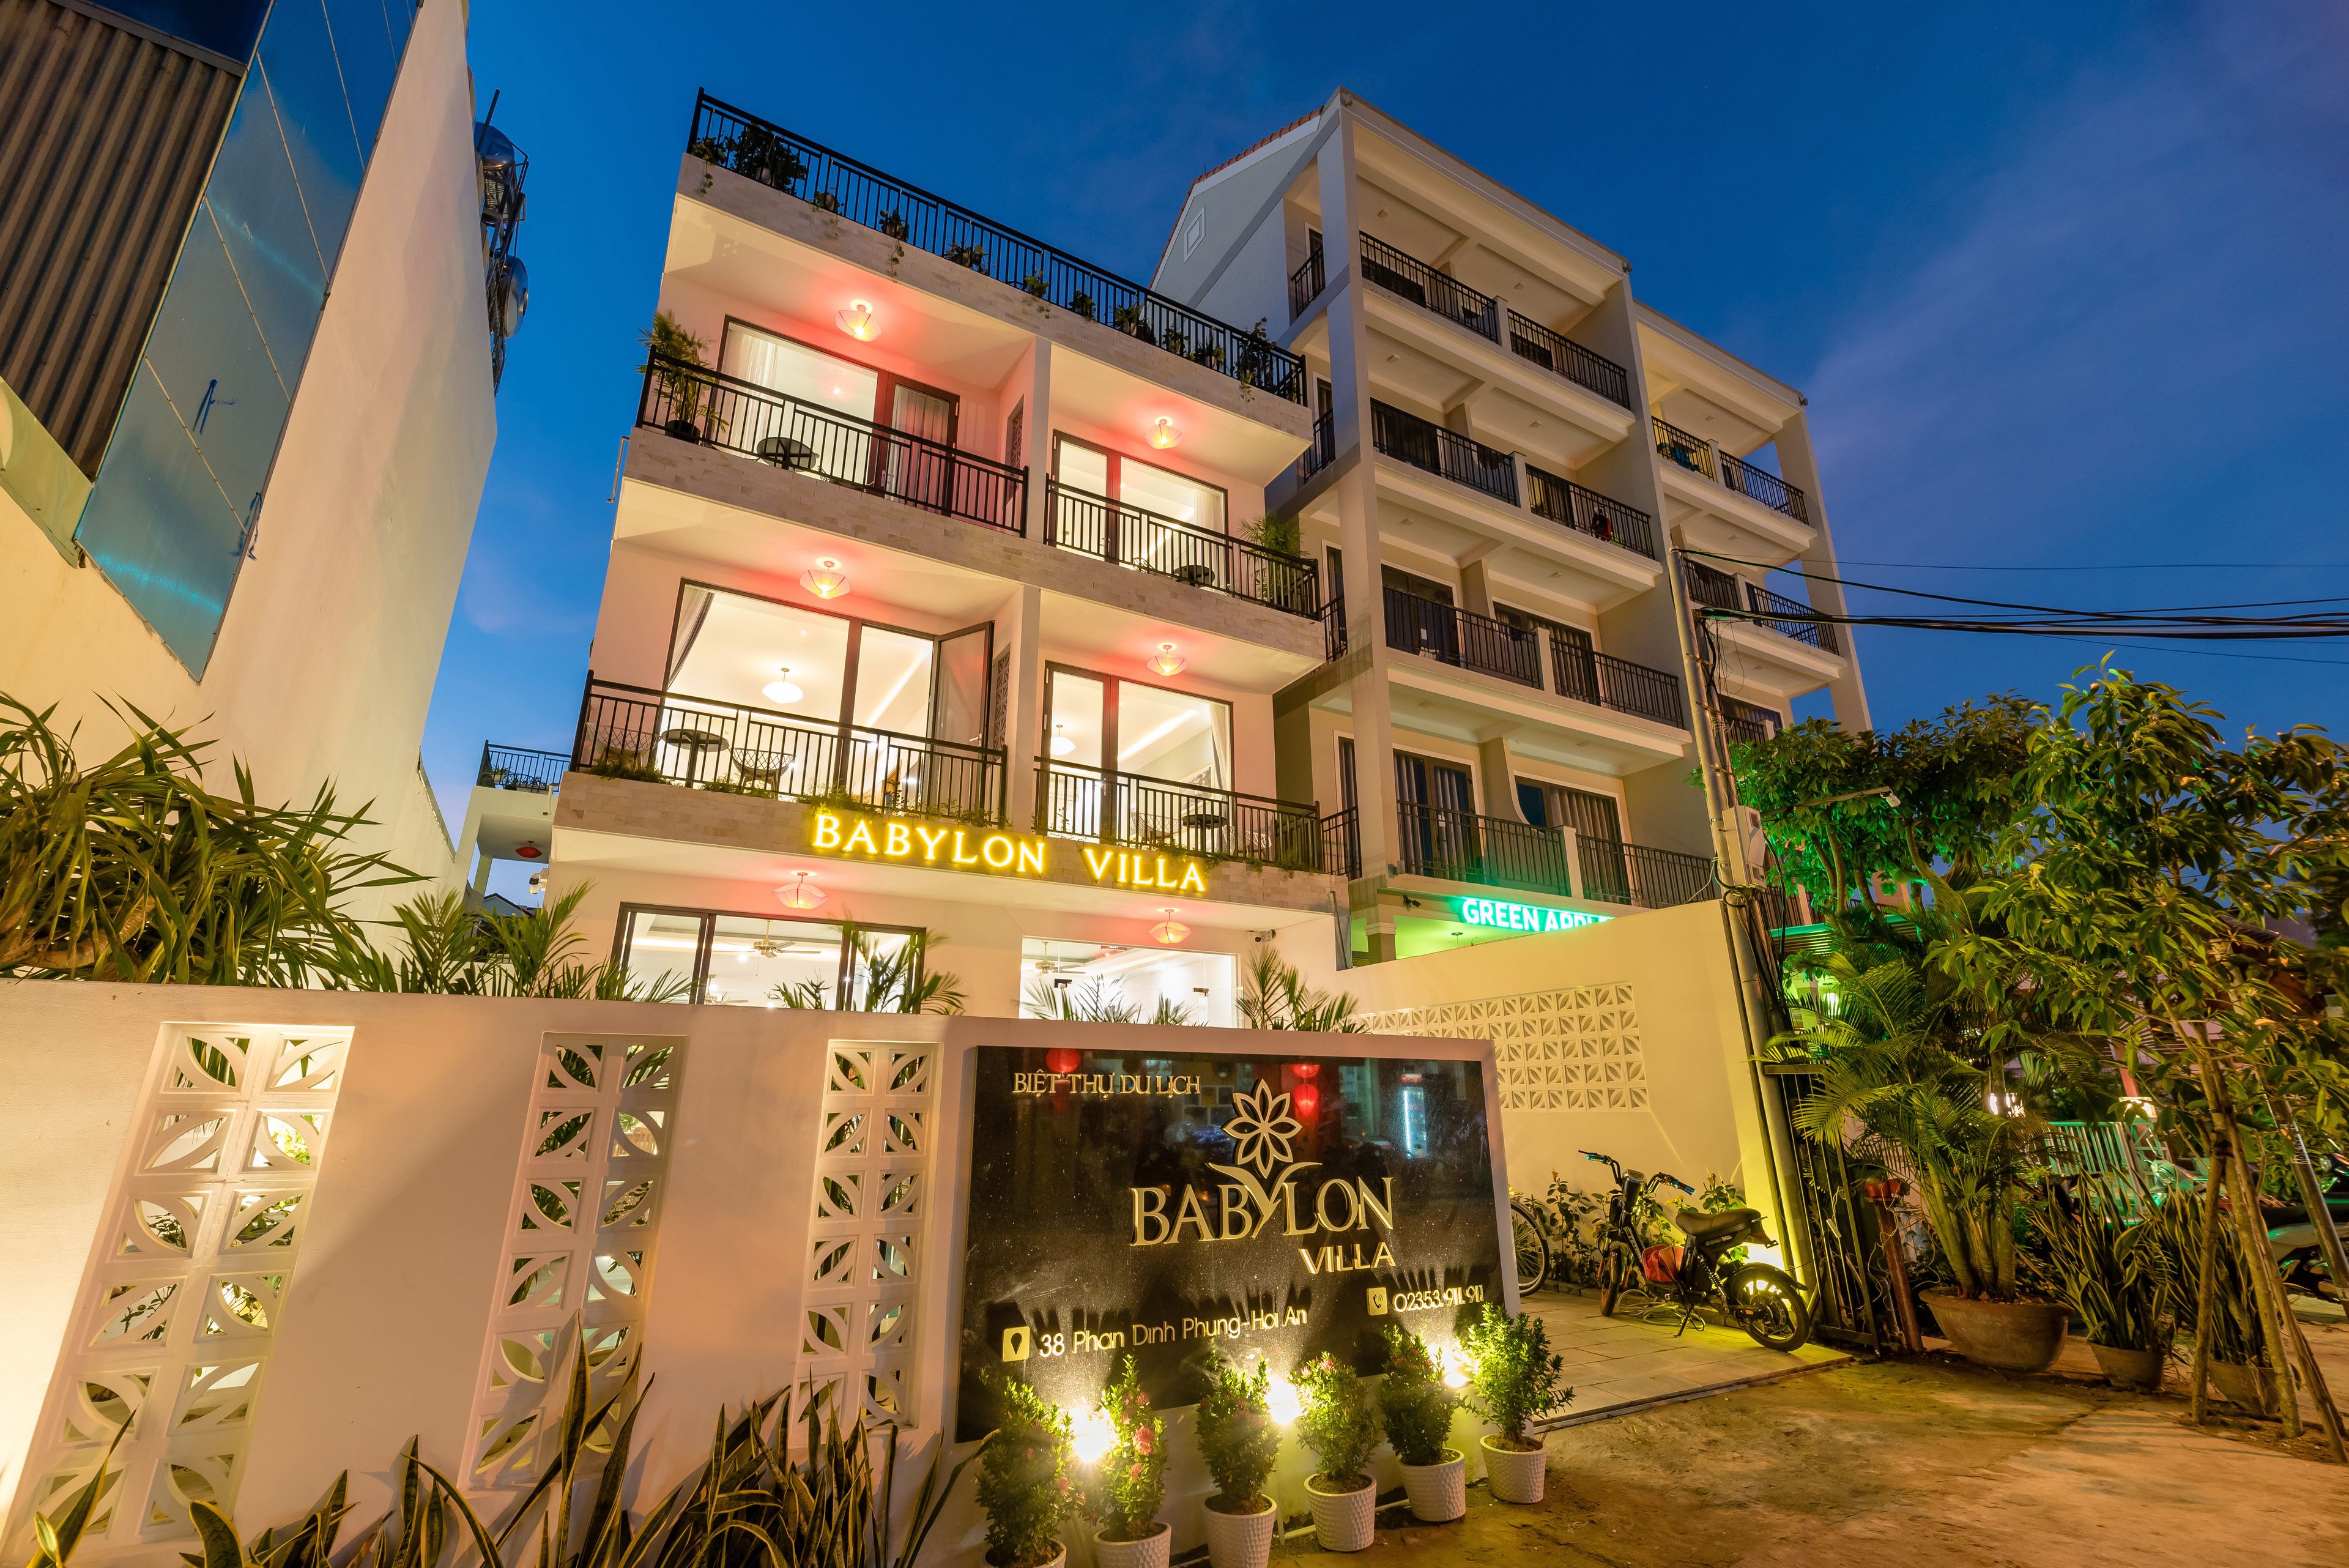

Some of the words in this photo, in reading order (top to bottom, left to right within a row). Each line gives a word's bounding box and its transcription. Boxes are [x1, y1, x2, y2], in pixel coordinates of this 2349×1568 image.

[812, 814, 1045, 876] BABYLON
[1084, 849, 1207, 893] VILLA
[1463, 898, 1540, 931] GREEN
[1012, 1069, 1061, 1097] BIỆT
[1120, 1075, 1151, 1094] DU
[1156, 1076, 1201, 1098] LỊCH
[1129, 1162, 1393, 1246] BABYLON
[1299, 1242, 1396, 1274] VILLA
[1039, 1333, 1065, 1358] 38
[1072, 1330, 1124, 1353] Phan
[1282, 1306, 1307, 1327] An
